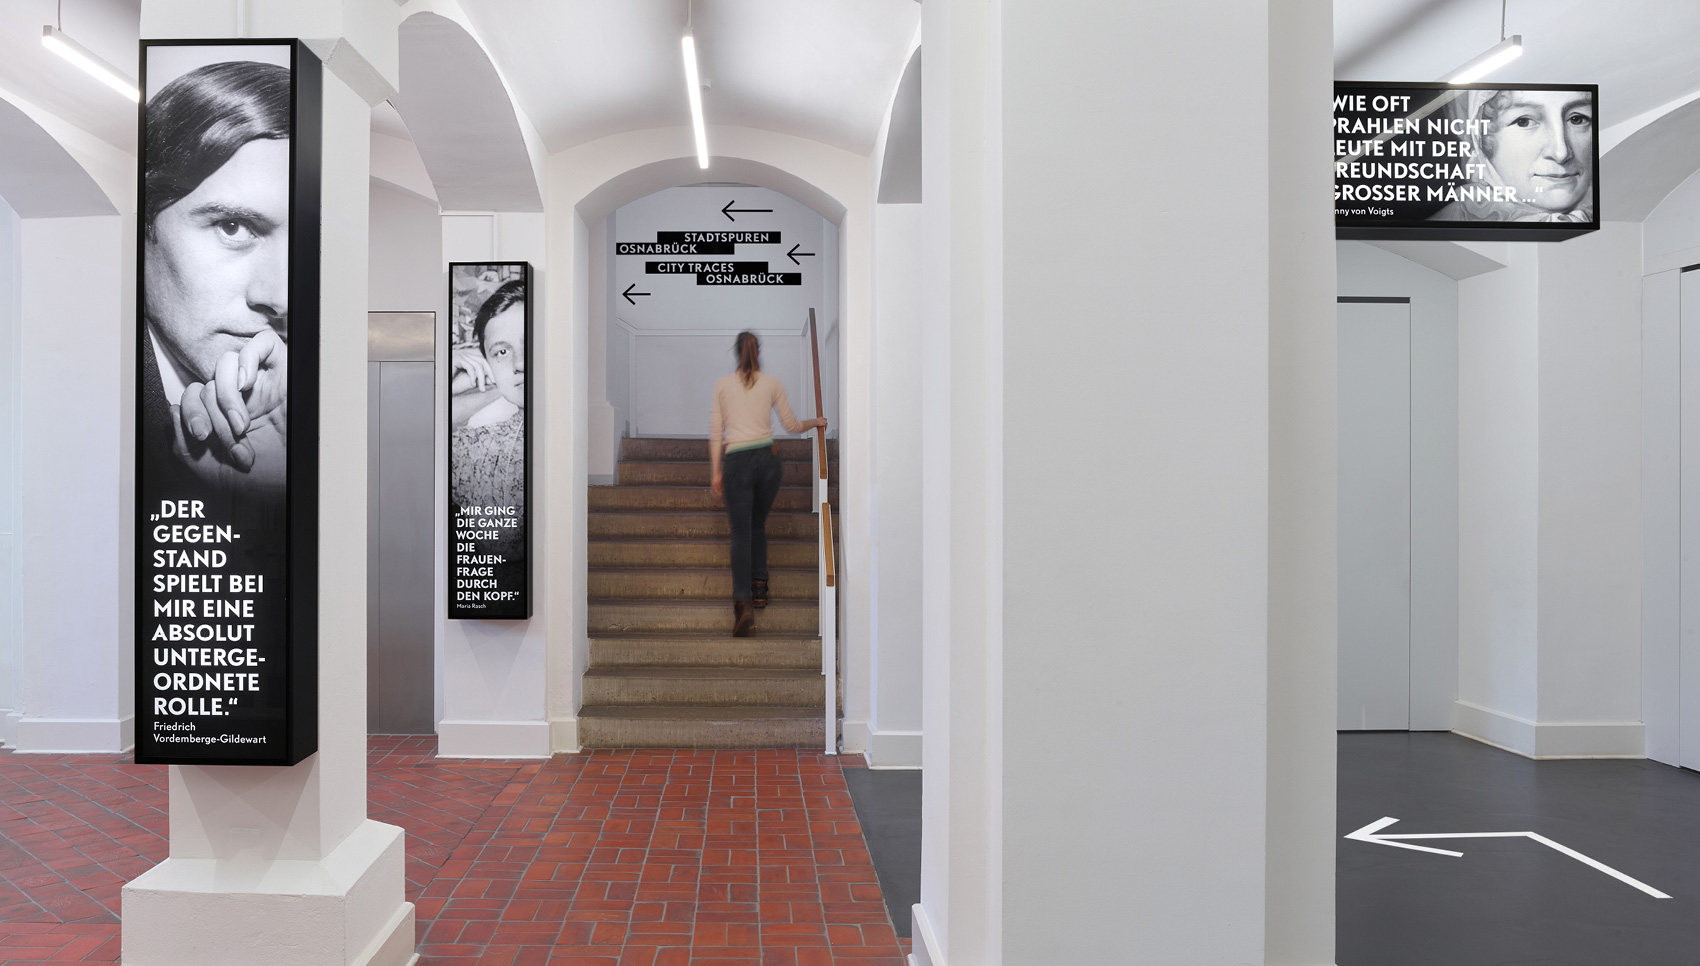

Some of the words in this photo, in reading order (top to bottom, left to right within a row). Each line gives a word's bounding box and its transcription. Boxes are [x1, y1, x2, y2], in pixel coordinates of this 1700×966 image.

[1372, 95, 1411, 112] OFT
[1427, 119, 1490, 135] NICHT
[1334, 139, 1384, 156] EUTE
[1392, 141, 1425, 156] MIT
[1432, 141, 1472, 157] DER
[1336, 162, 1486, 180] REUNDSCHAFT
[1427, 182, 1518, 202] MÄNNER
[1368, 207, 1393, 216] Voigts
[685, 233, 768, 242] STADTSPUREN
[619, 242, 698, 254] OSNABRÜCK
[658, 263, 684, 272] CITY
[688, 263, 734, 272] TRACES
[706, 273, 784, 284] OSNABRÜCK
[151, 500, 205, 521] „DER
[455, 506, 482, 517] „MIR
[485, 506, 515, 515] GING
[457, 518, 475, 527] DIE
[478, 518, 517, 527] GANZE
[154, 525, 240, 543] GEGEN-
[456, 530, 499, 540] WOCHE
[457, 543, 475, 552] DIE
[154, 550, 226, 567] STAND
[457, 555, 506, 564] FRAUEN-
[457, 567, 493, 576] FRAGE
[154, 575, 222, 592] SPIELT
[230, 575, 263, 592] BEI
[457, 580, 497, 588] DURCH
[457, 592, 479, 600] DEN
[484, 592, 519, 600] KOPF.“
[155, 600, 196, 617] MIR
[204, 600, 254, 617] EINE
[152, 624, 254, 641] ABSOLUT
[154, 648, 265, 666] UNTERGE-
[154, 673, 259, 691] ORDNETE
[155, 698, 238, 715] ROLLE.“
[154, 722, 195, 731] Friedrich
[153, 734, 266, 744] Vordemberge-Gildewart
